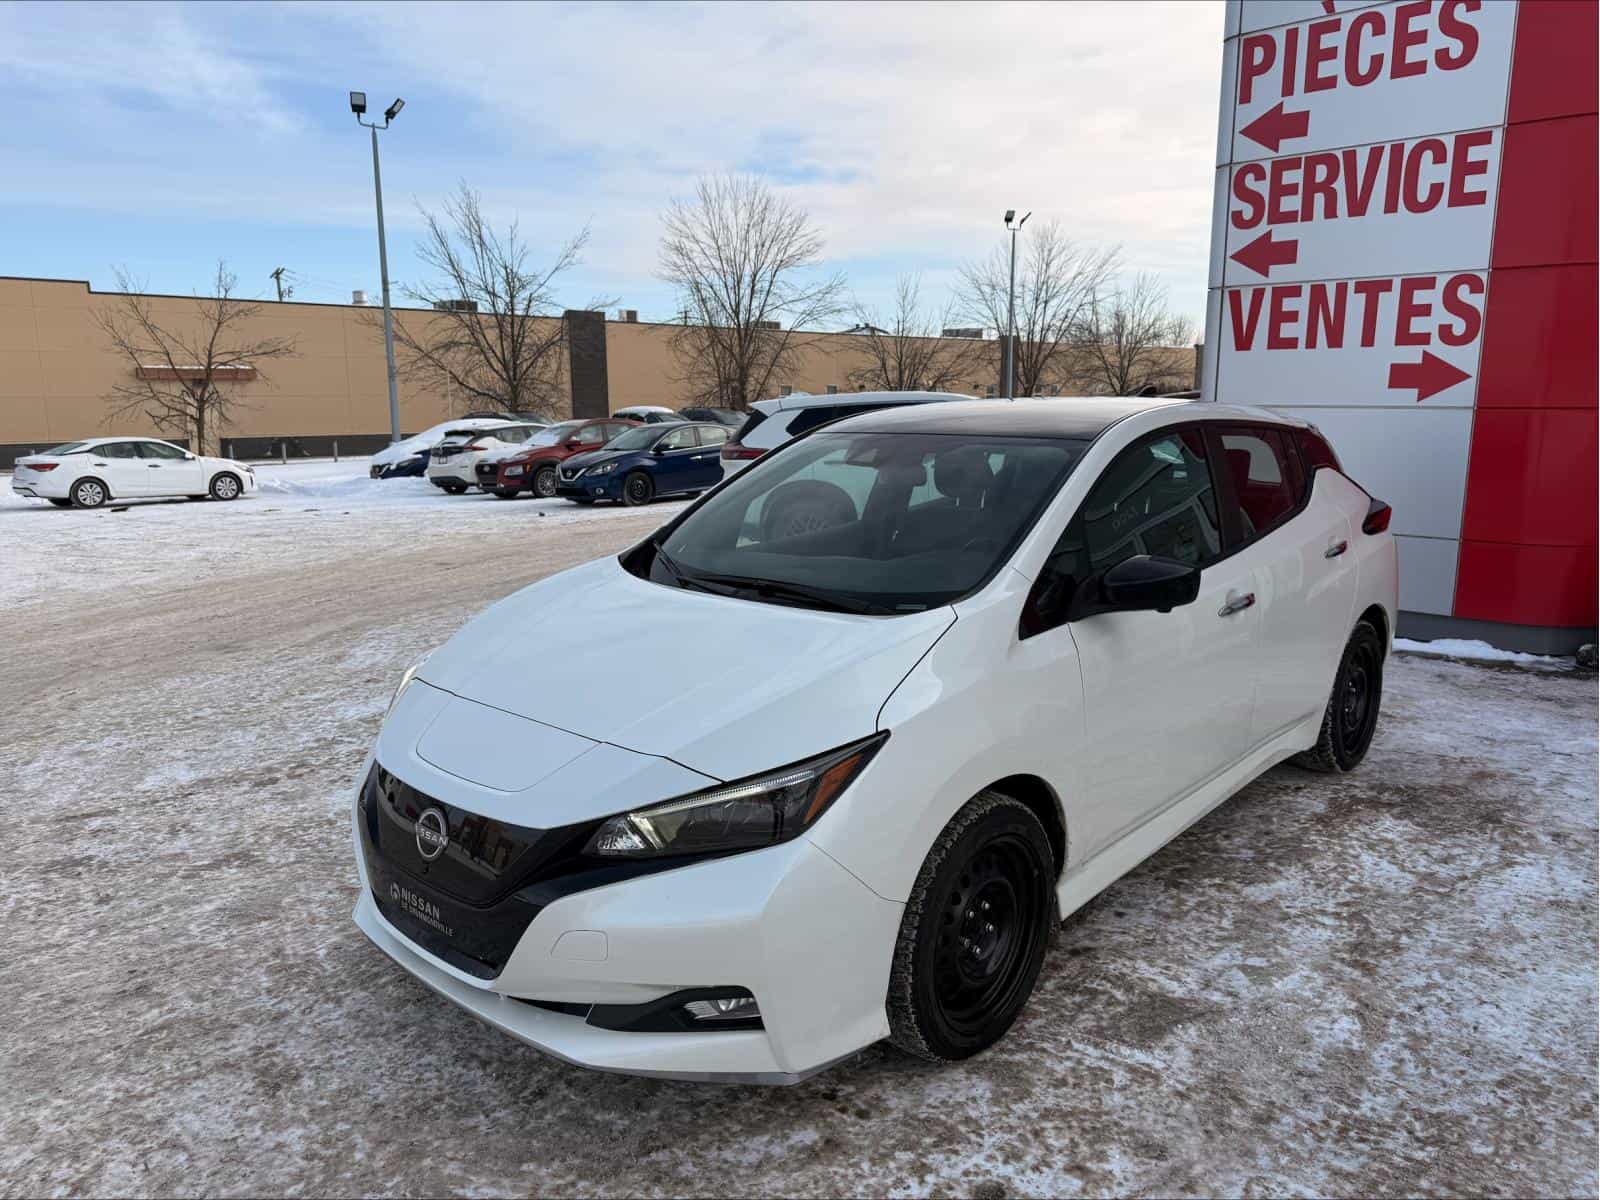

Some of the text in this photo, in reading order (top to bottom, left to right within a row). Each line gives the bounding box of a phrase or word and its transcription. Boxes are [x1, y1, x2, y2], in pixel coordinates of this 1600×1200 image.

[1238, 0, 1482, 105] PIÈCES
[1230, 130, 1493, 230] SERVICE
[1228, 273, 1485, 352] VENTES
[401, 887, 440, 920] NISSAN
